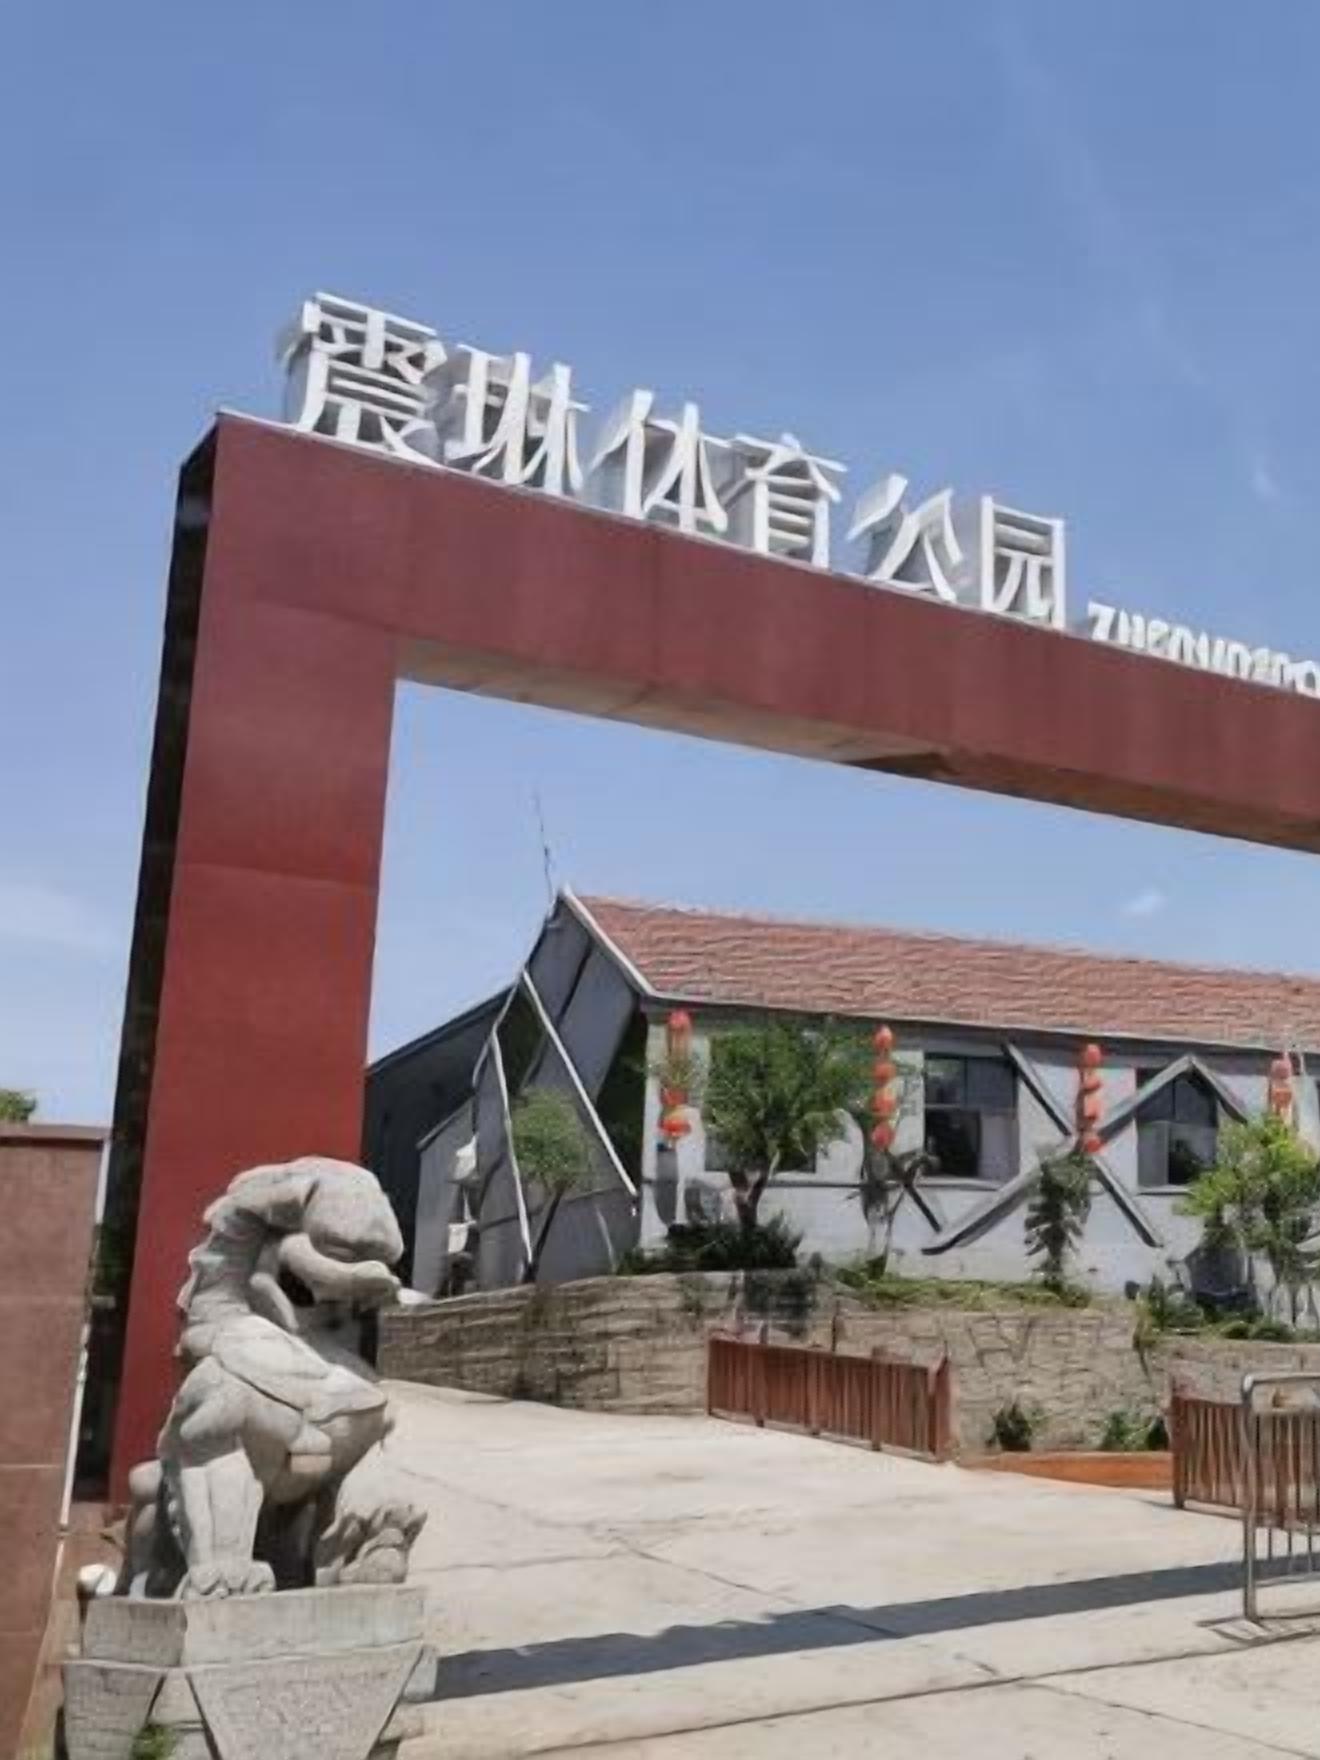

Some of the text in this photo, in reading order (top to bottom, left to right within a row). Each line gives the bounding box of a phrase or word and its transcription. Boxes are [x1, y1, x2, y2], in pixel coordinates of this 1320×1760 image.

[284, 292, 1067, 630] 震琳体育公园
